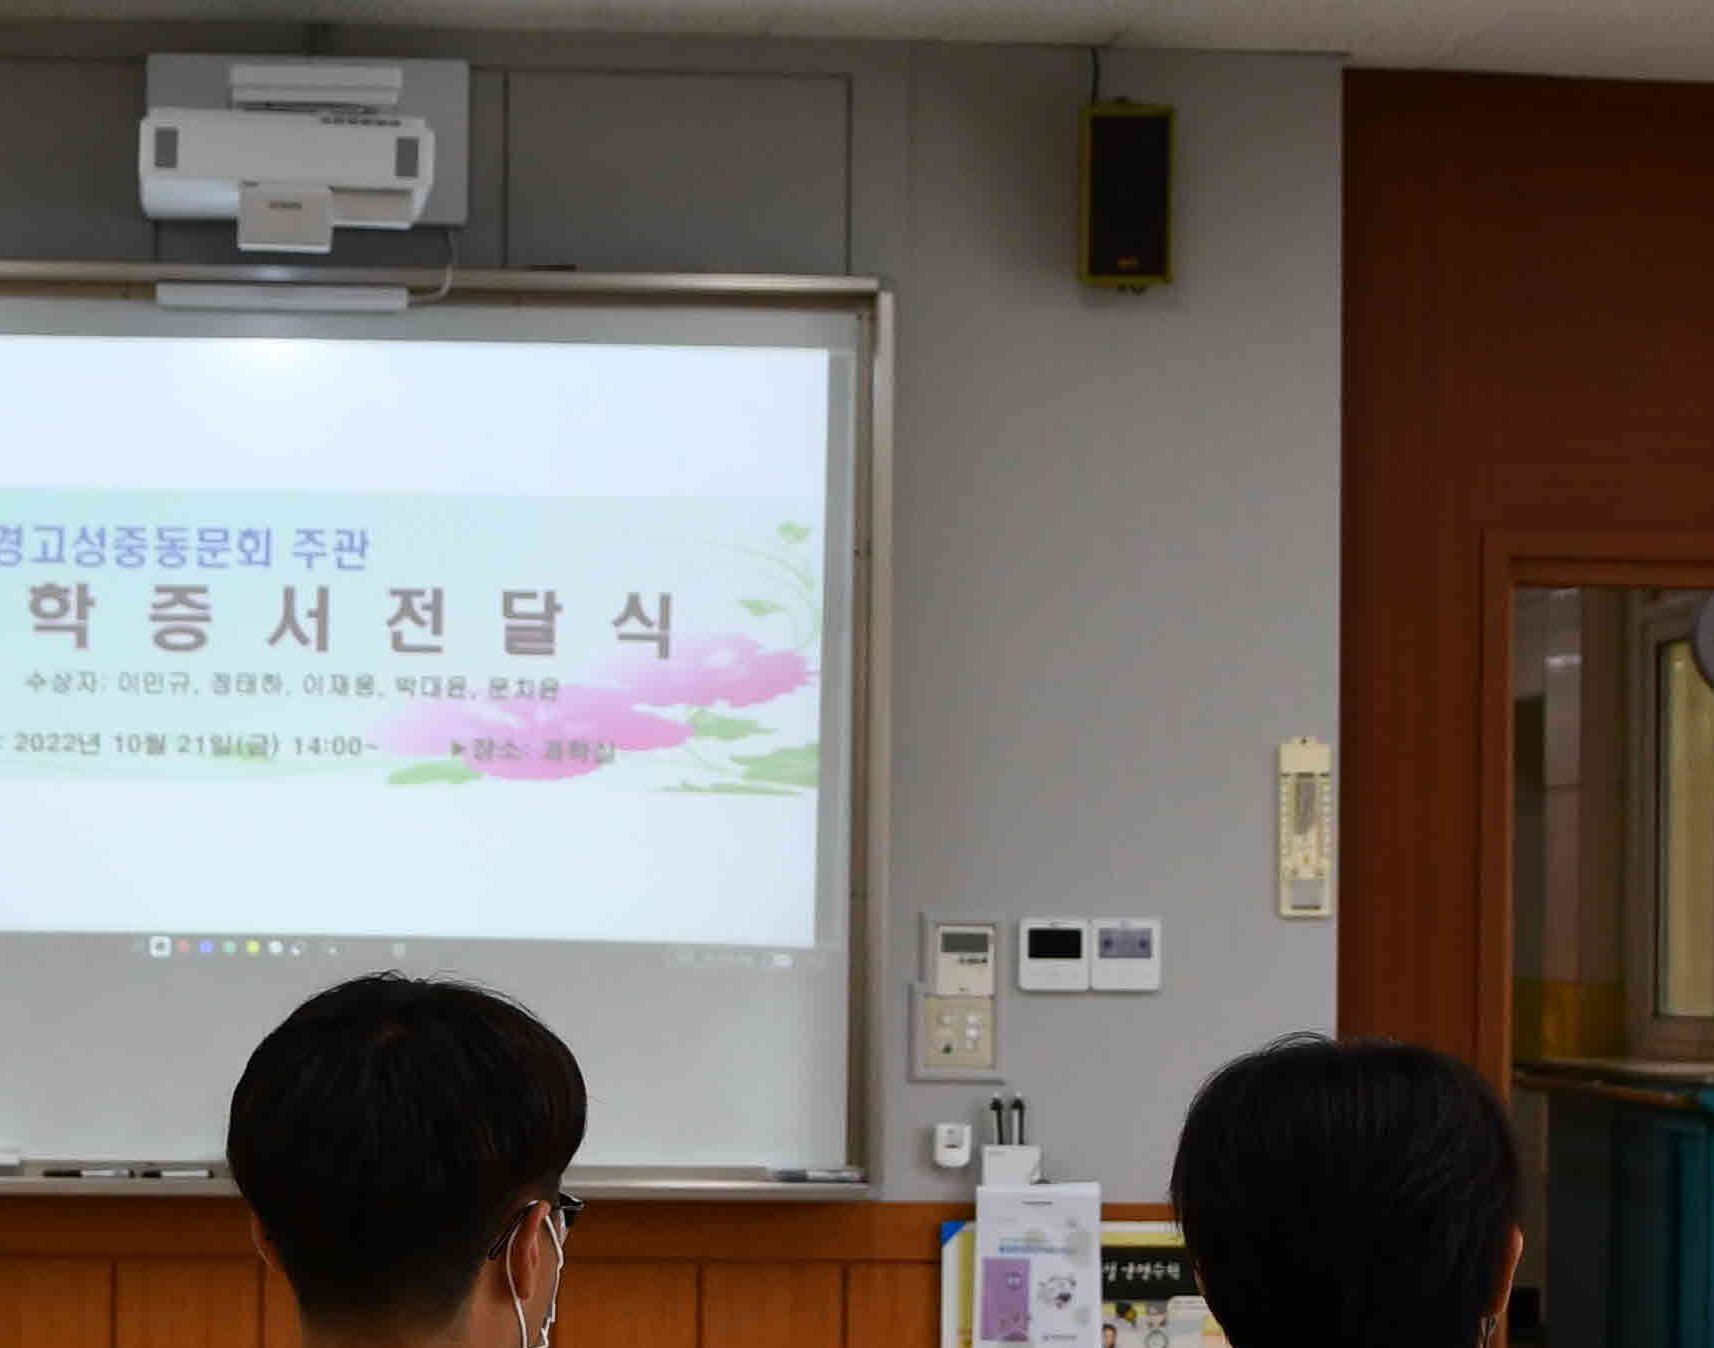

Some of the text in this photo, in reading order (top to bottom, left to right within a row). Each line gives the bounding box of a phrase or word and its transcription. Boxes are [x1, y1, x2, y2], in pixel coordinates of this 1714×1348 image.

[293, 528, 370, 571] 주관
[28, 581, 96, 650] 학
[149, 585, 213, 652] 증
[267, 586, 329, 653] 서
[386, 587, 443, 654] 전
[502, 589, 563, 656] 달
[612, 592, 671, 659] 식
[14, 731, 101, 756] 2022년
[112, 732, 167, 756] 10월
